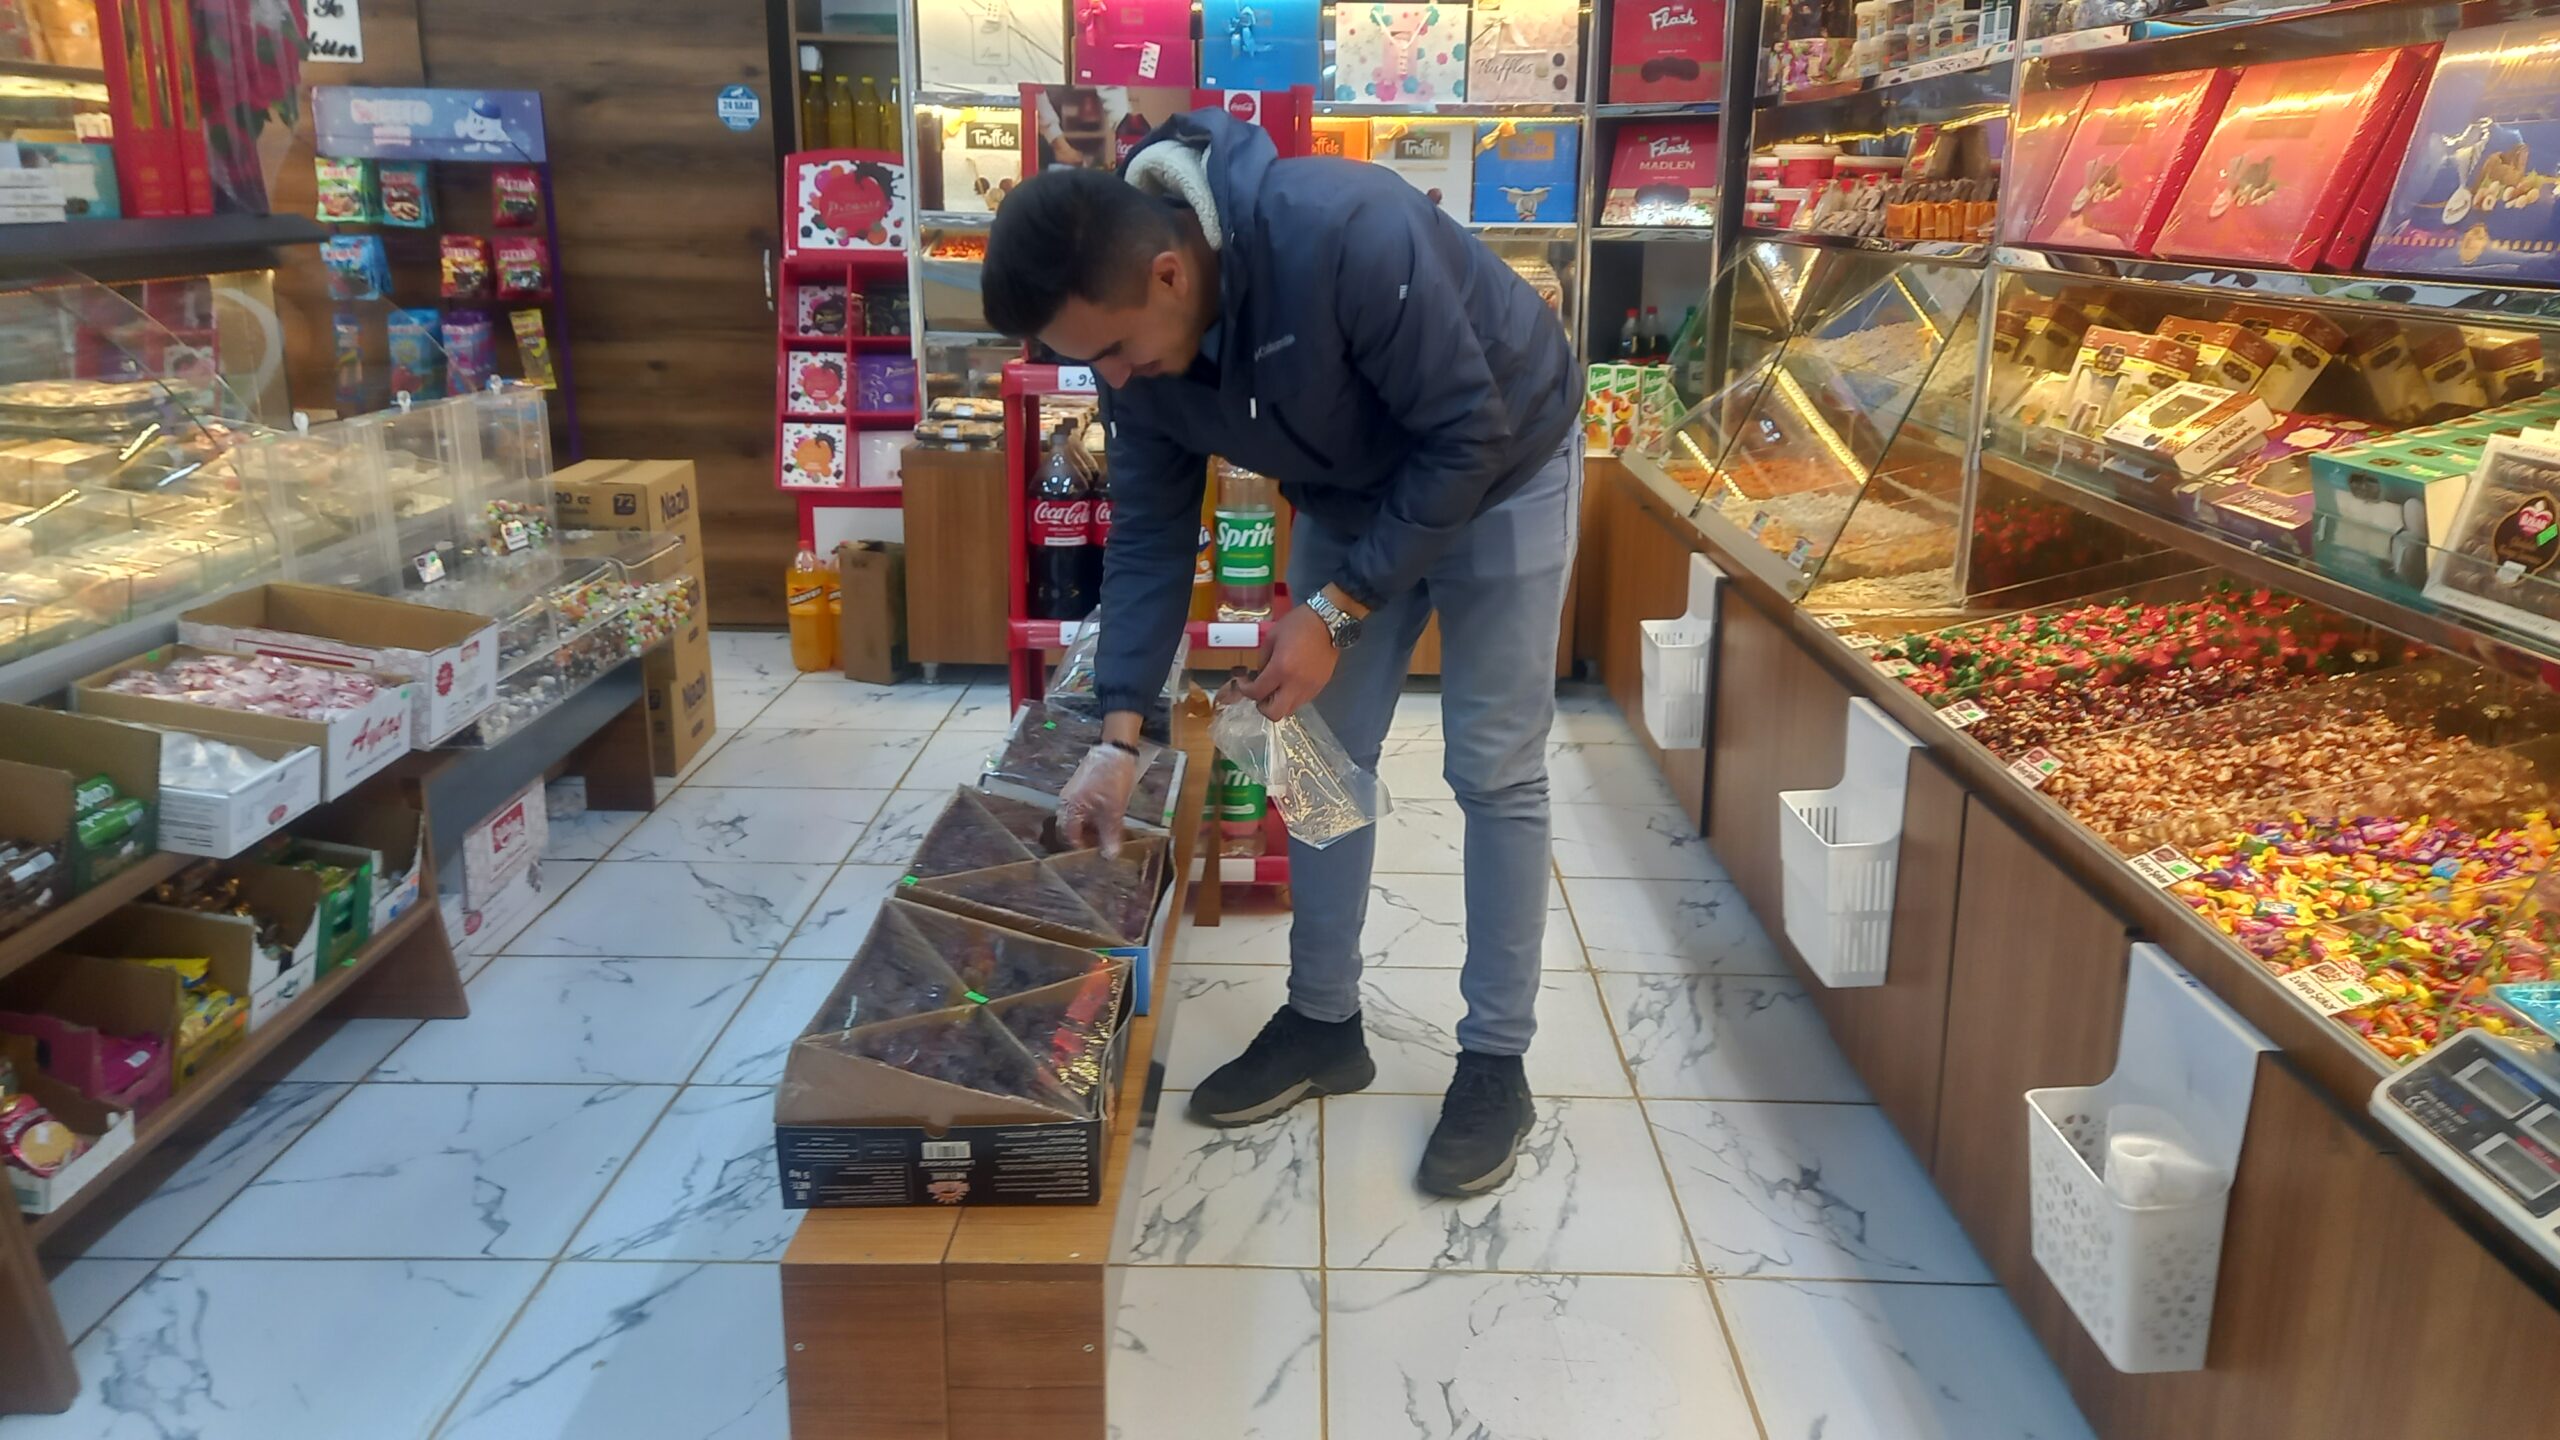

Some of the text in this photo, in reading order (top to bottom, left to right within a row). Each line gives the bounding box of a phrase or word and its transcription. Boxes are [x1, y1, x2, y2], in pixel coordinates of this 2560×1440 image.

[1649, 6, 1698, 31] Flash
[1649, 137, 1693, 158] Flash
[1639, 160, 1696, 170] MADLEN
[2288, 975, 2316, 999] Evliya
